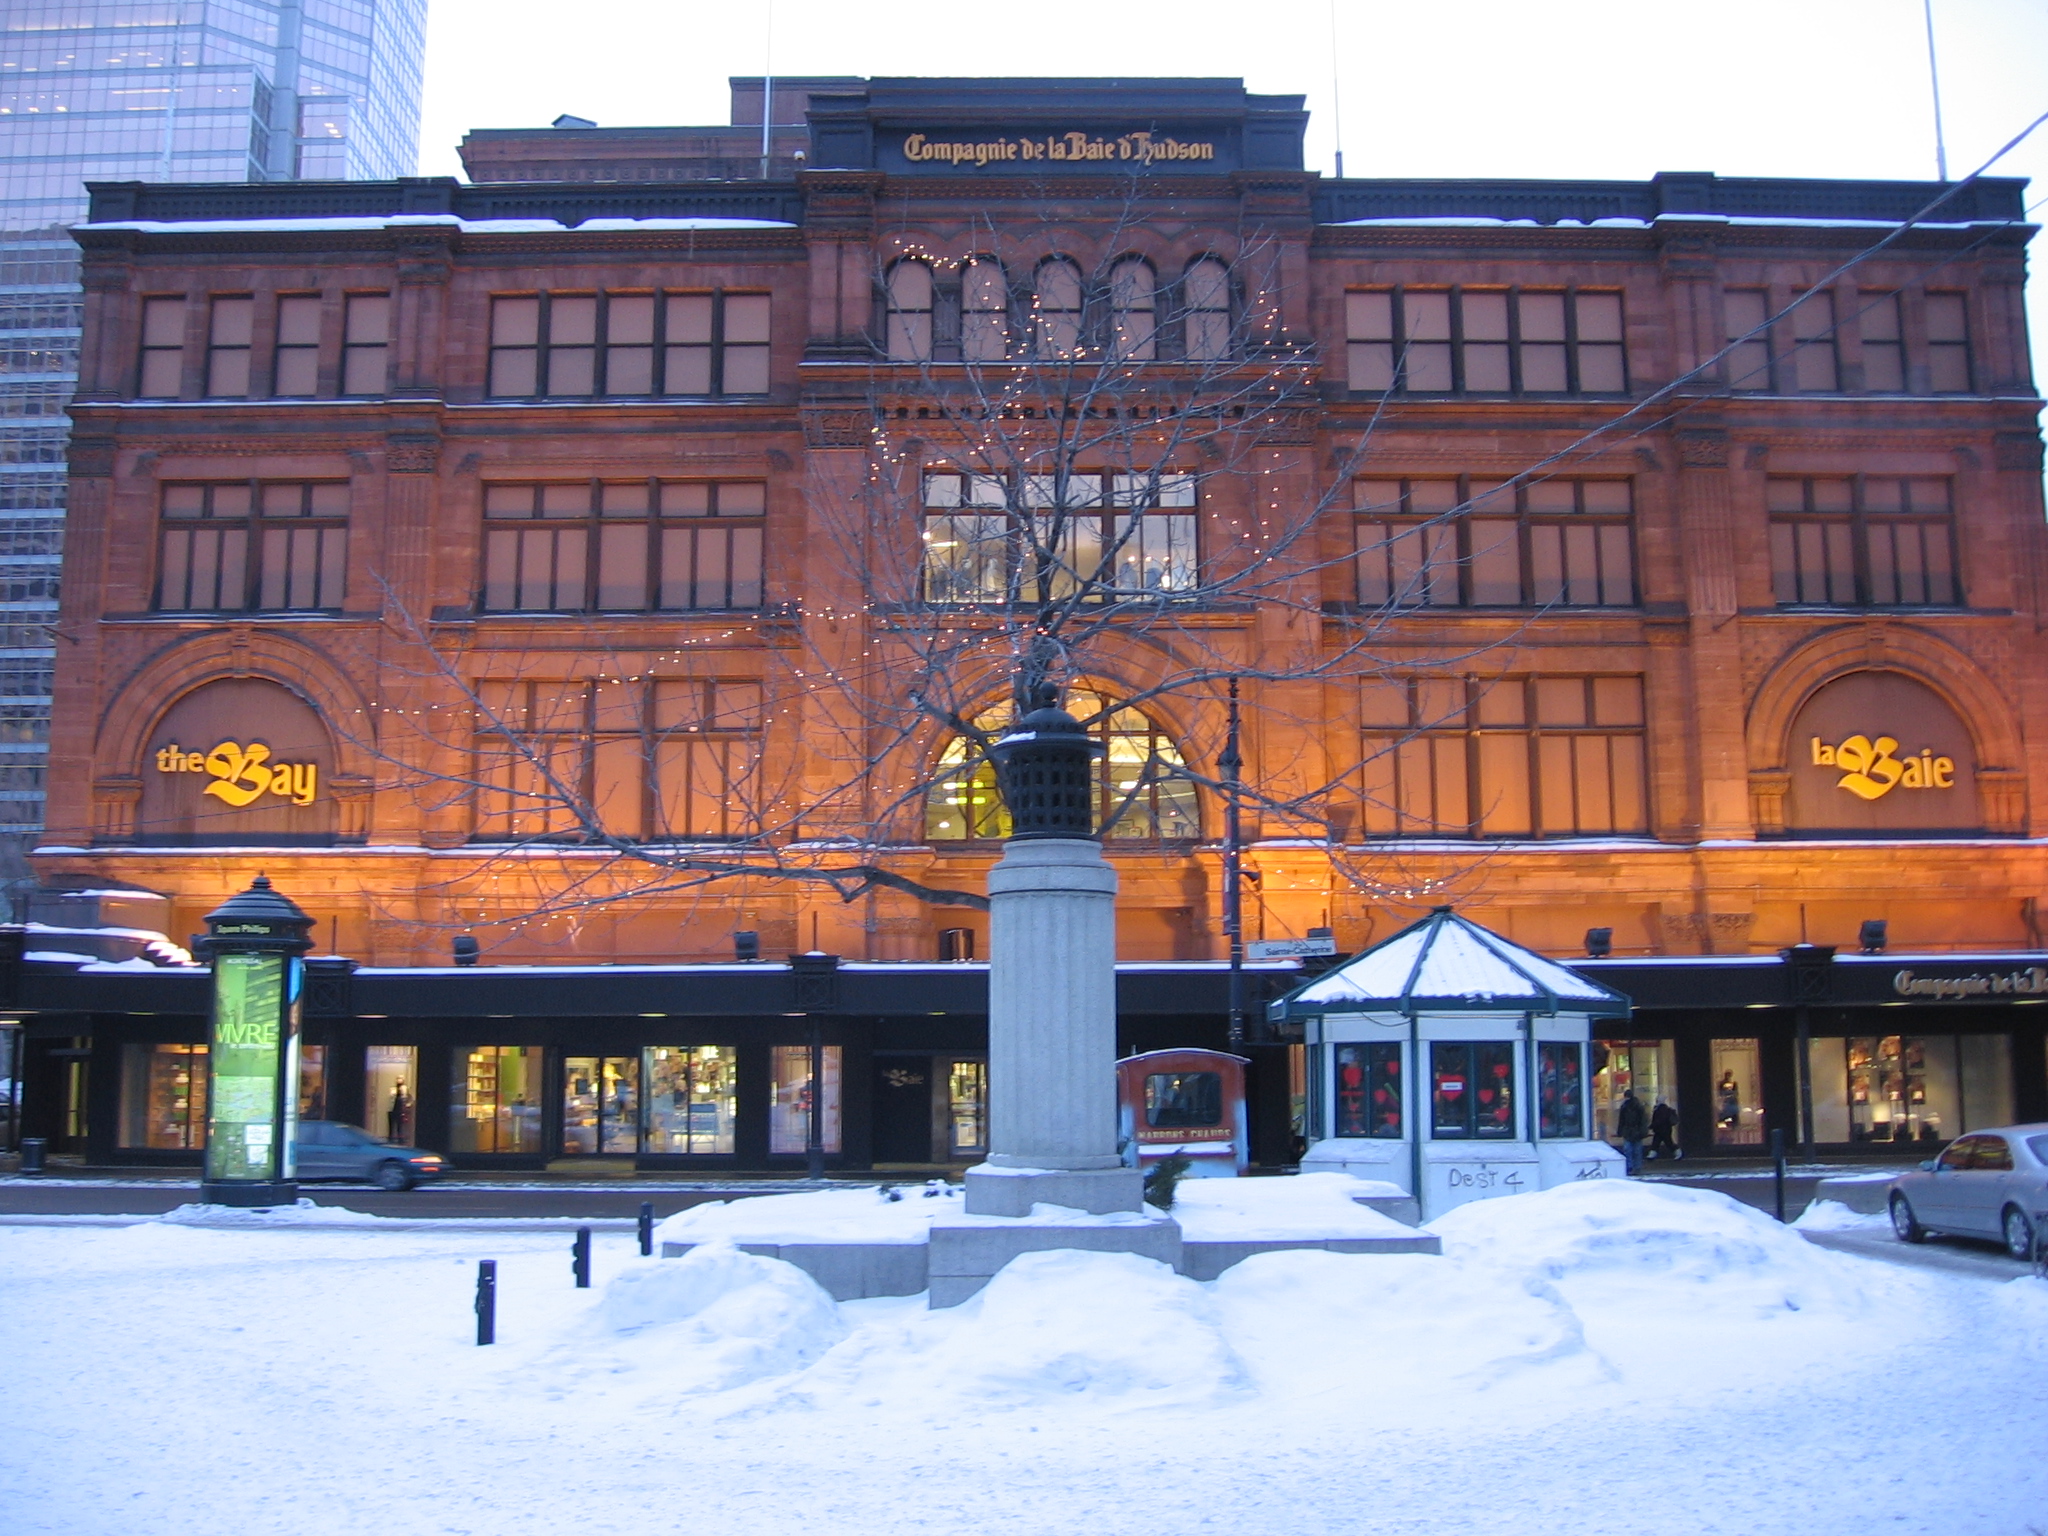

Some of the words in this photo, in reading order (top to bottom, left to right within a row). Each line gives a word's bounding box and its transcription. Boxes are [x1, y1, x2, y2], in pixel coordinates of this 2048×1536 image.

[904, 132, 1018, 167] Compagnie
[1019, 137, 1046, 161] de
[1047, 136, 1067, 160] la
[1064, 131, 1116, 161] Baie
[155, 744, 205, 773] the
[203, 741, 318, 807] Bay
[1811, 736, 1836, 766] la
[1836, 734, 1955, 801] Baie
